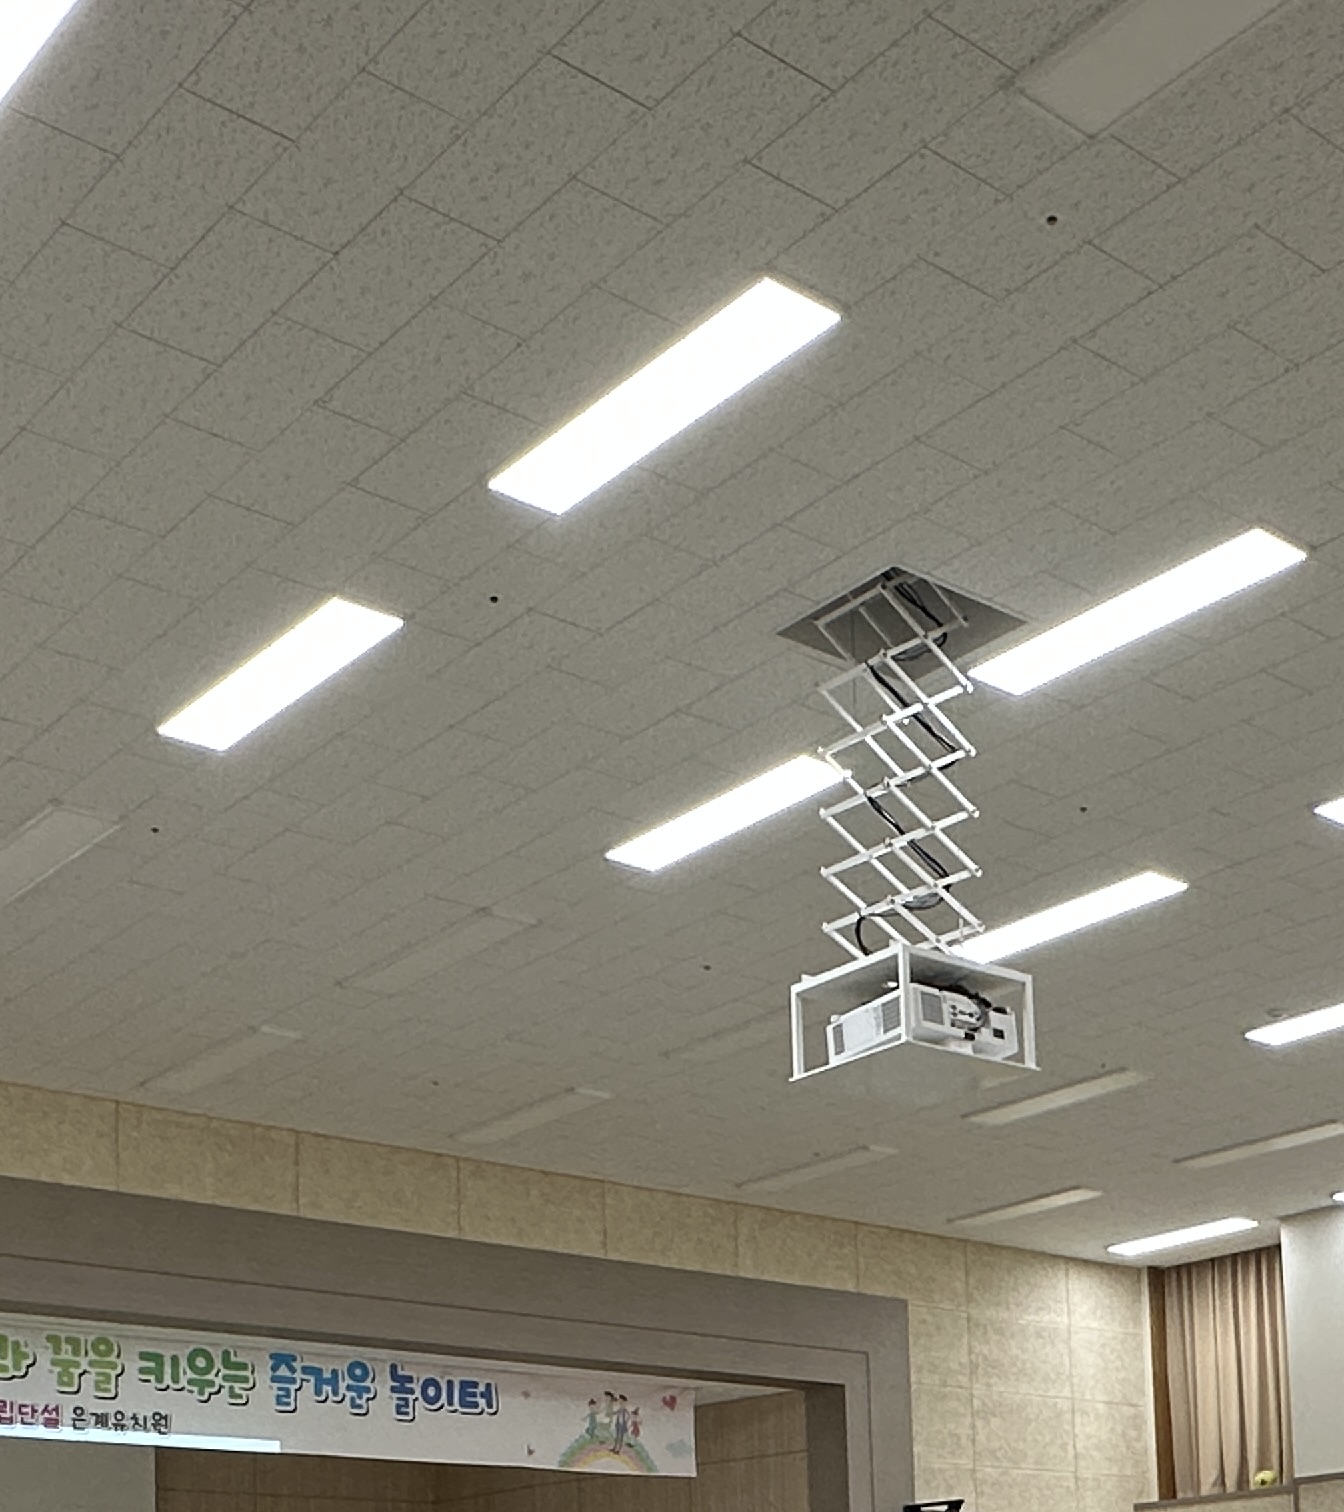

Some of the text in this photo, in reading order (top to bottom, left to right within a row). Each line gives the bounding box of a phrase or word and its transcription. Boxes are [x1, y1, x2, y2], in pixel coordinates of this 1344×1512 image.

[45, 1333, 124, 1398] 꿈을
[138, 1347, 254, 1404] 키우는
[268, 1352, 375, 1414] 즐거운
[388, 1362, 498, 1421] 놀이터
[70, 1406, 170, 1434] 은계유치원
